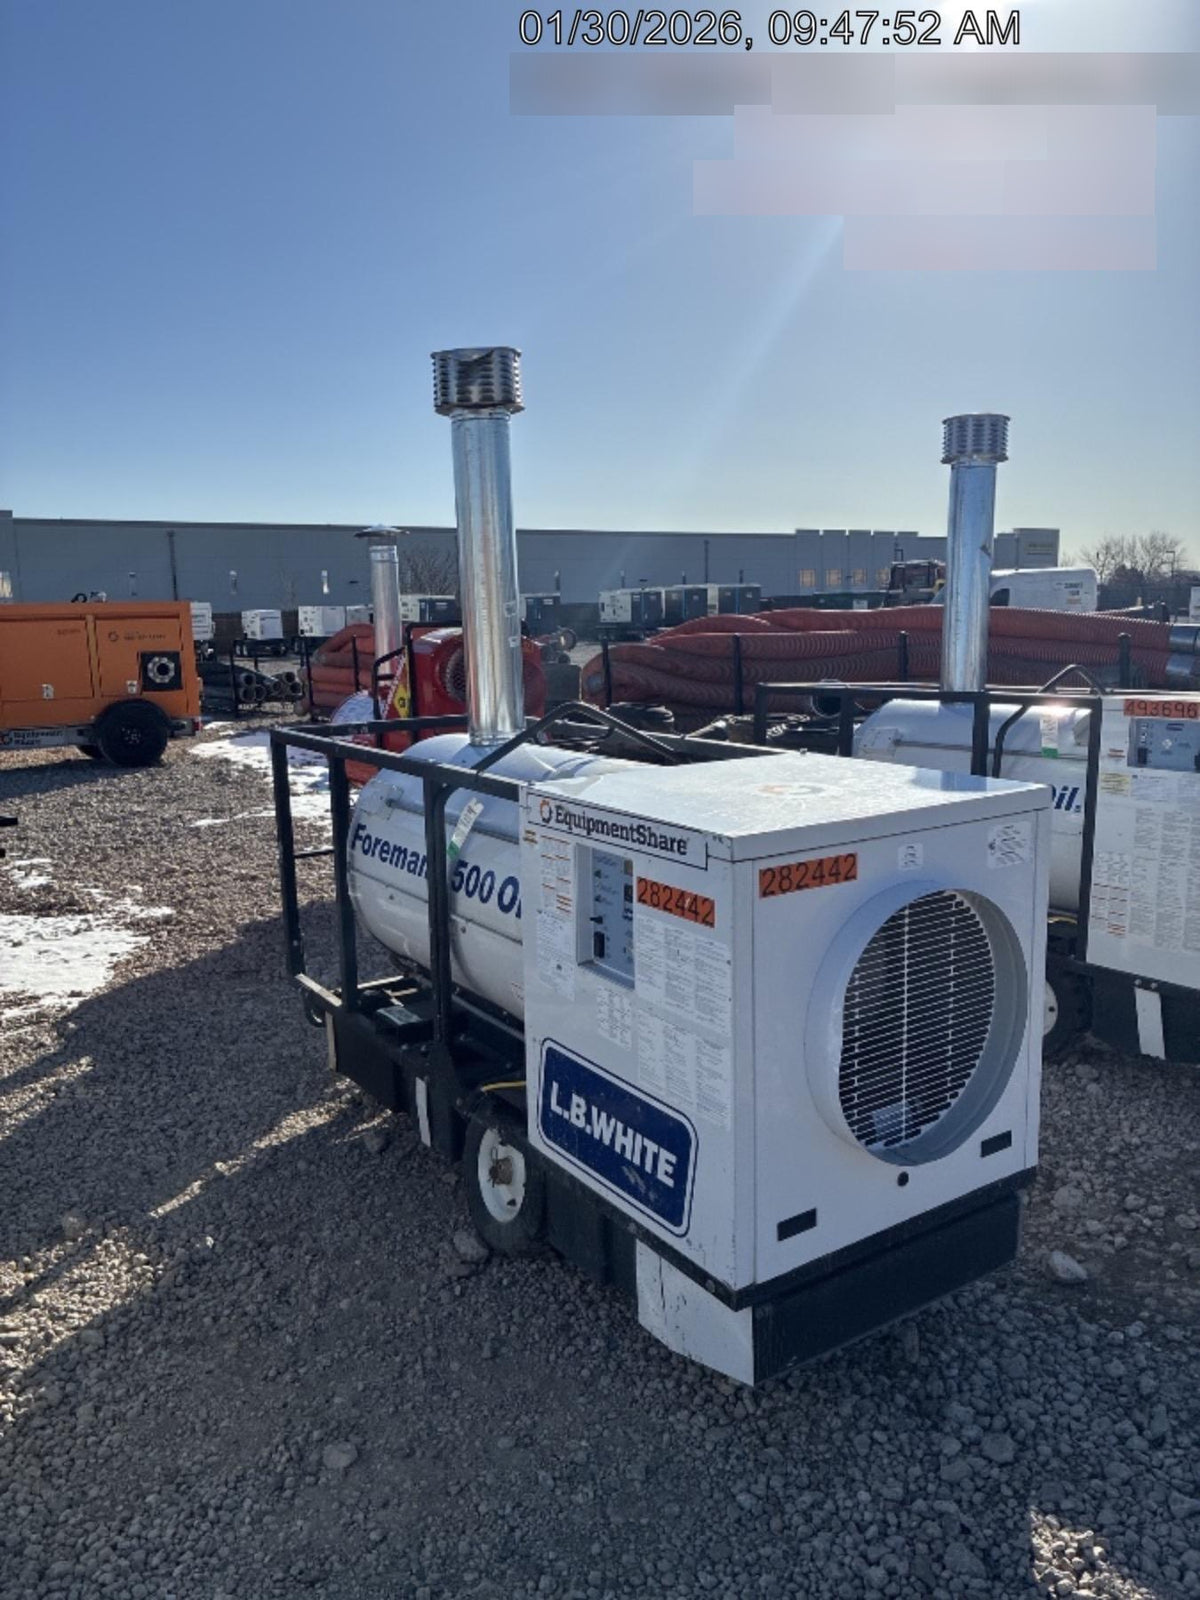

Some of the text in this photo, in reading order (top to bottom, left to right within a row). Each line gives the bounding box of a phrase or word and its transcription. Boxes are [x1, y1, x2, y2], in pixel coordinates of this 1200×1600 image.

[1051, 784, 1081, 813] il.
[554, 805, 688, 855] EquipmentShare
[451, 858, 497, 904] 500
[761, 853, 858, 896] 282442
[638, 877, 714, 928] 282442
